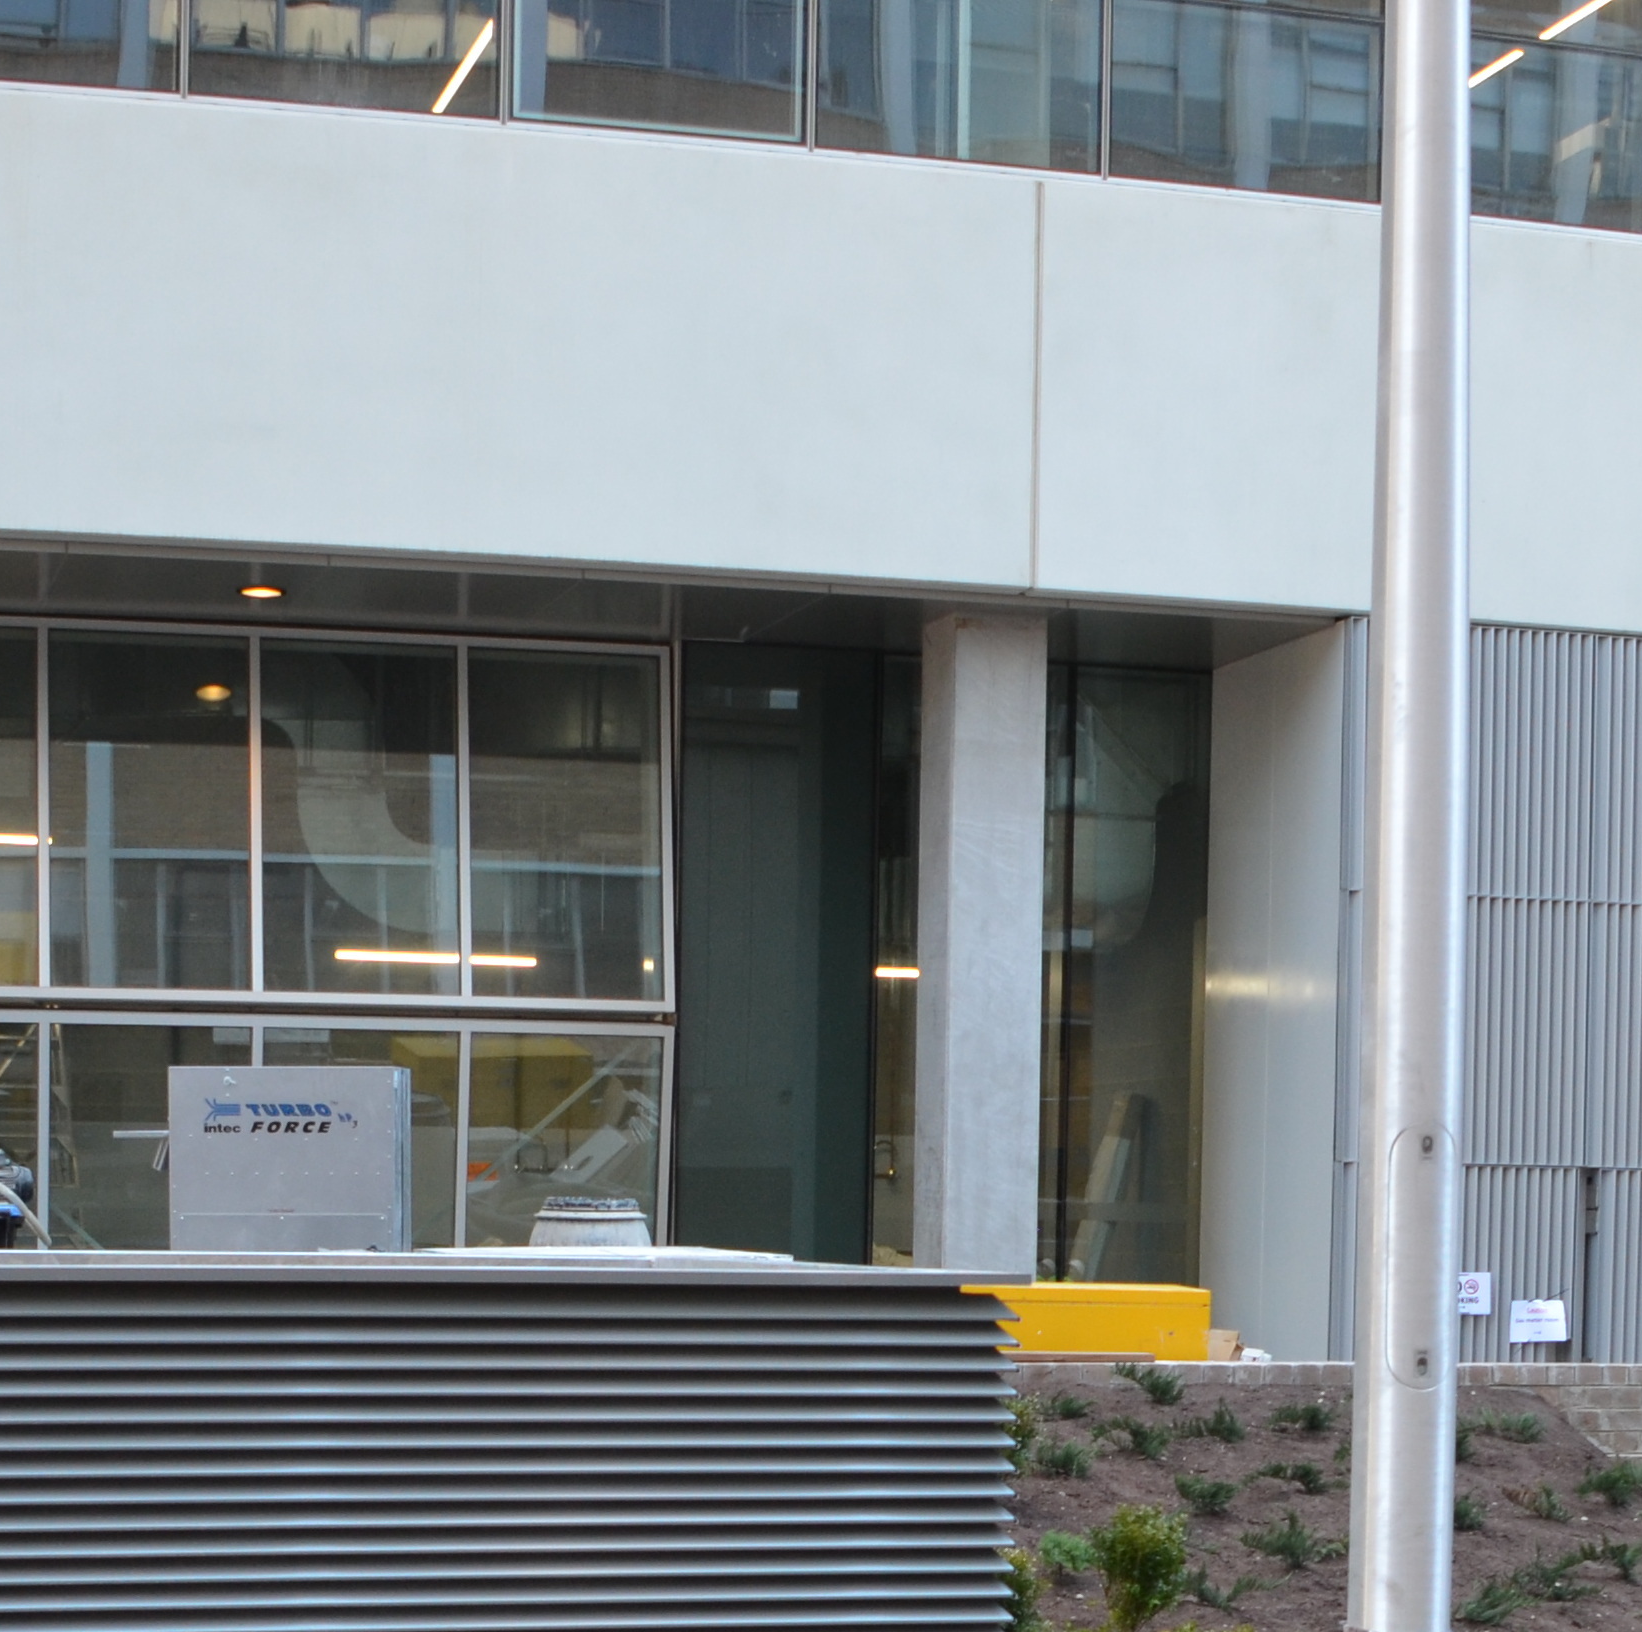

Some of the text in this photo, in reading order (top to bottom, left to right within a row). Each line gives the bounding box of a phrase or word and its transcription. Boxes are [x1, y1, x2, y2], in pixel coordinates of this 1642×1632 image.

[245, 1103, 333, 1118] TURBO
[203, 1121, 332, 1134] intec FORCE
